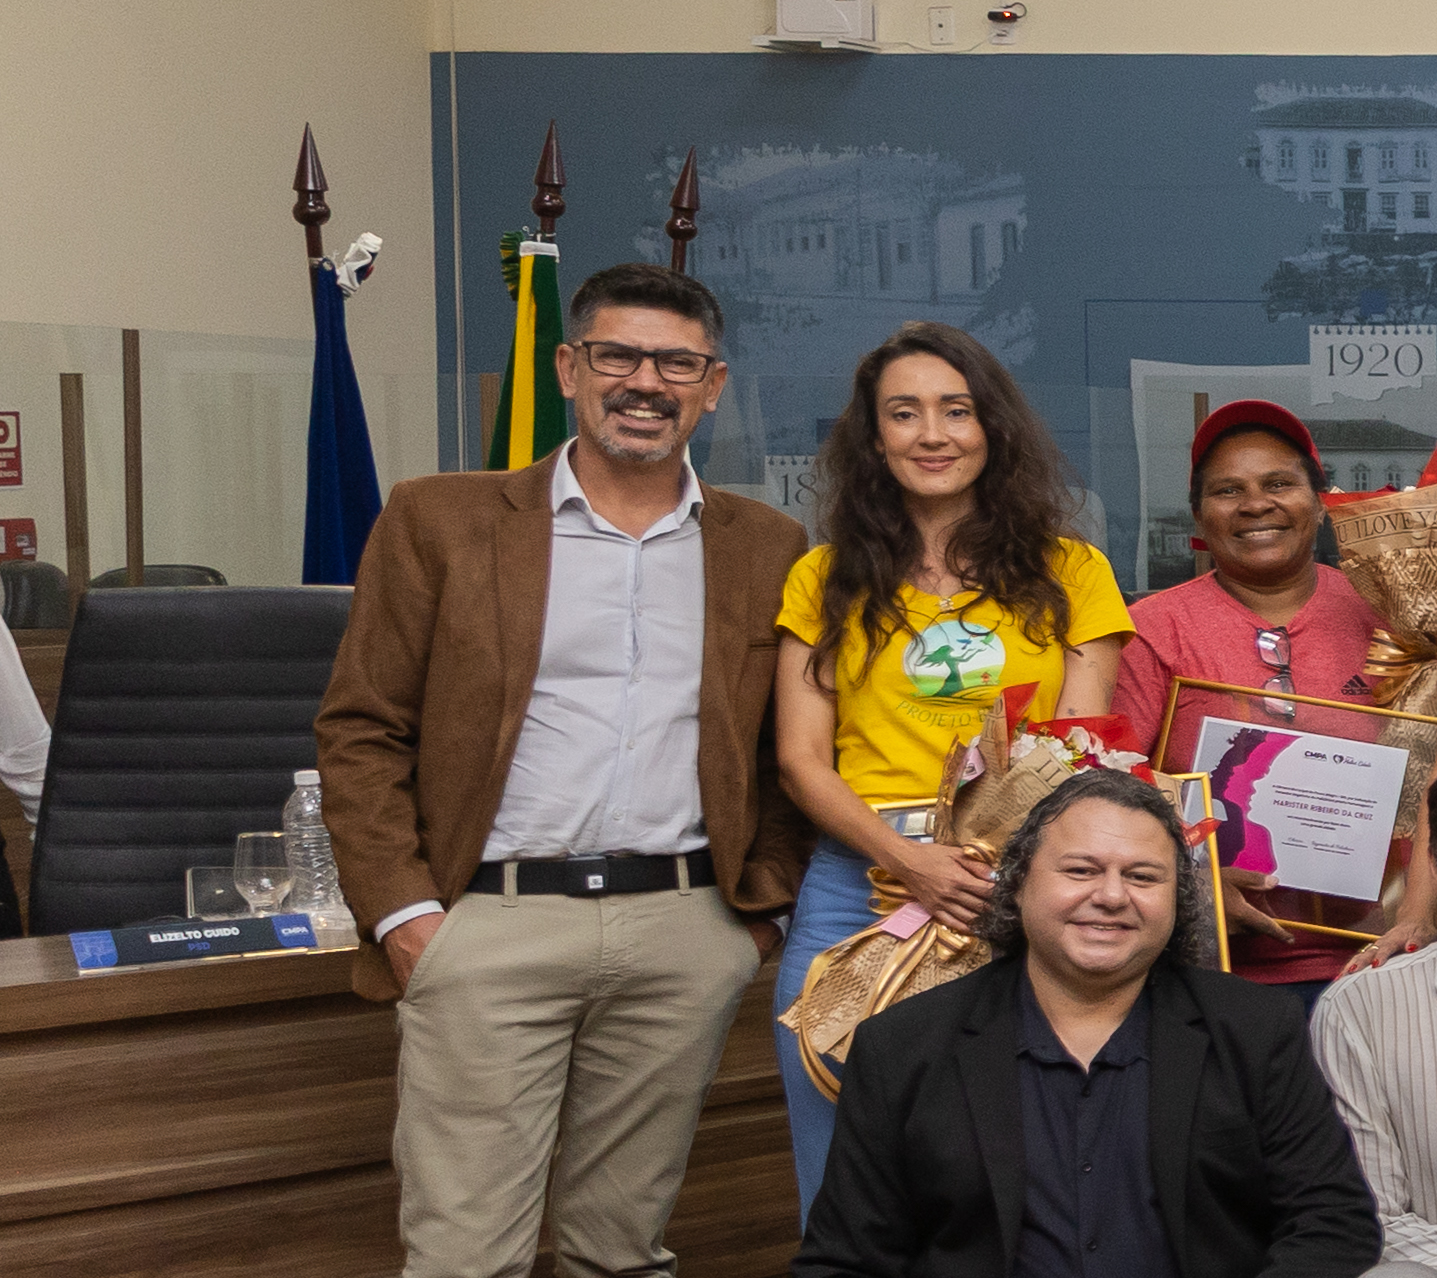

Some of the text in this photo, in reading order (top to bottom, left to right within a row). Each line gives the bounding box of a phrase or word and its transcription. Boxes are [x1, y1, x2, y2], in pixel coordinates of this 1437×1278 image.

[1327, 343, 1423, 377] 1920
[895, 699, 971, 728] PROJETO
[1304, 750, 1328, 760] CMPA
[1273, 798, 1374, 821] MARISTER RIBEIRO DA CRUZ
[149, 925, 309, 944] ELIZELTO GUIDO CMPA
